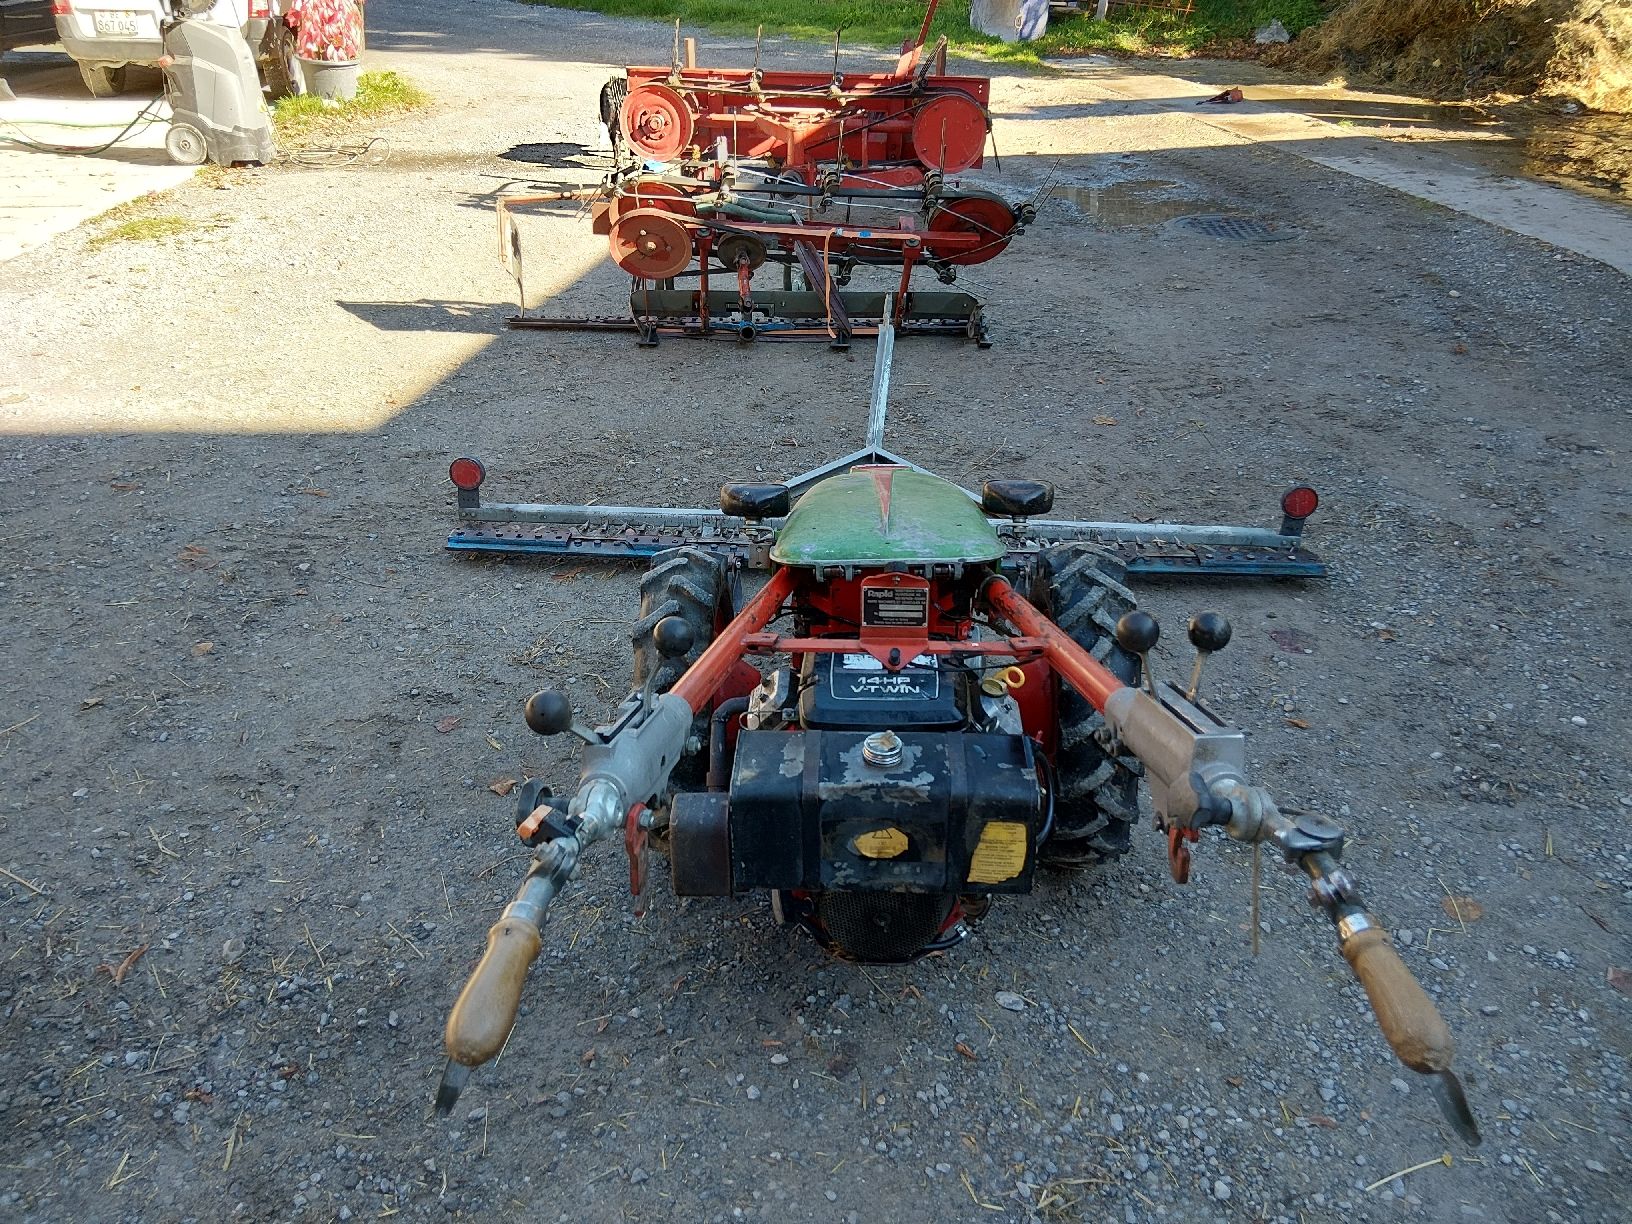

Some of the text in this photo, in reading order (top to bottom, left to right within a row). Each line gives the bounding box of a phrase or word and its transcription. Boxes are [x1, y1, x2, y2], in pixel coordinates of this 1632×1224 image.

[98, 20, 136, 32] 867 045
[867, 590, 894, 599] Rapid
[850, 685, 920, 694] V-TWIN
